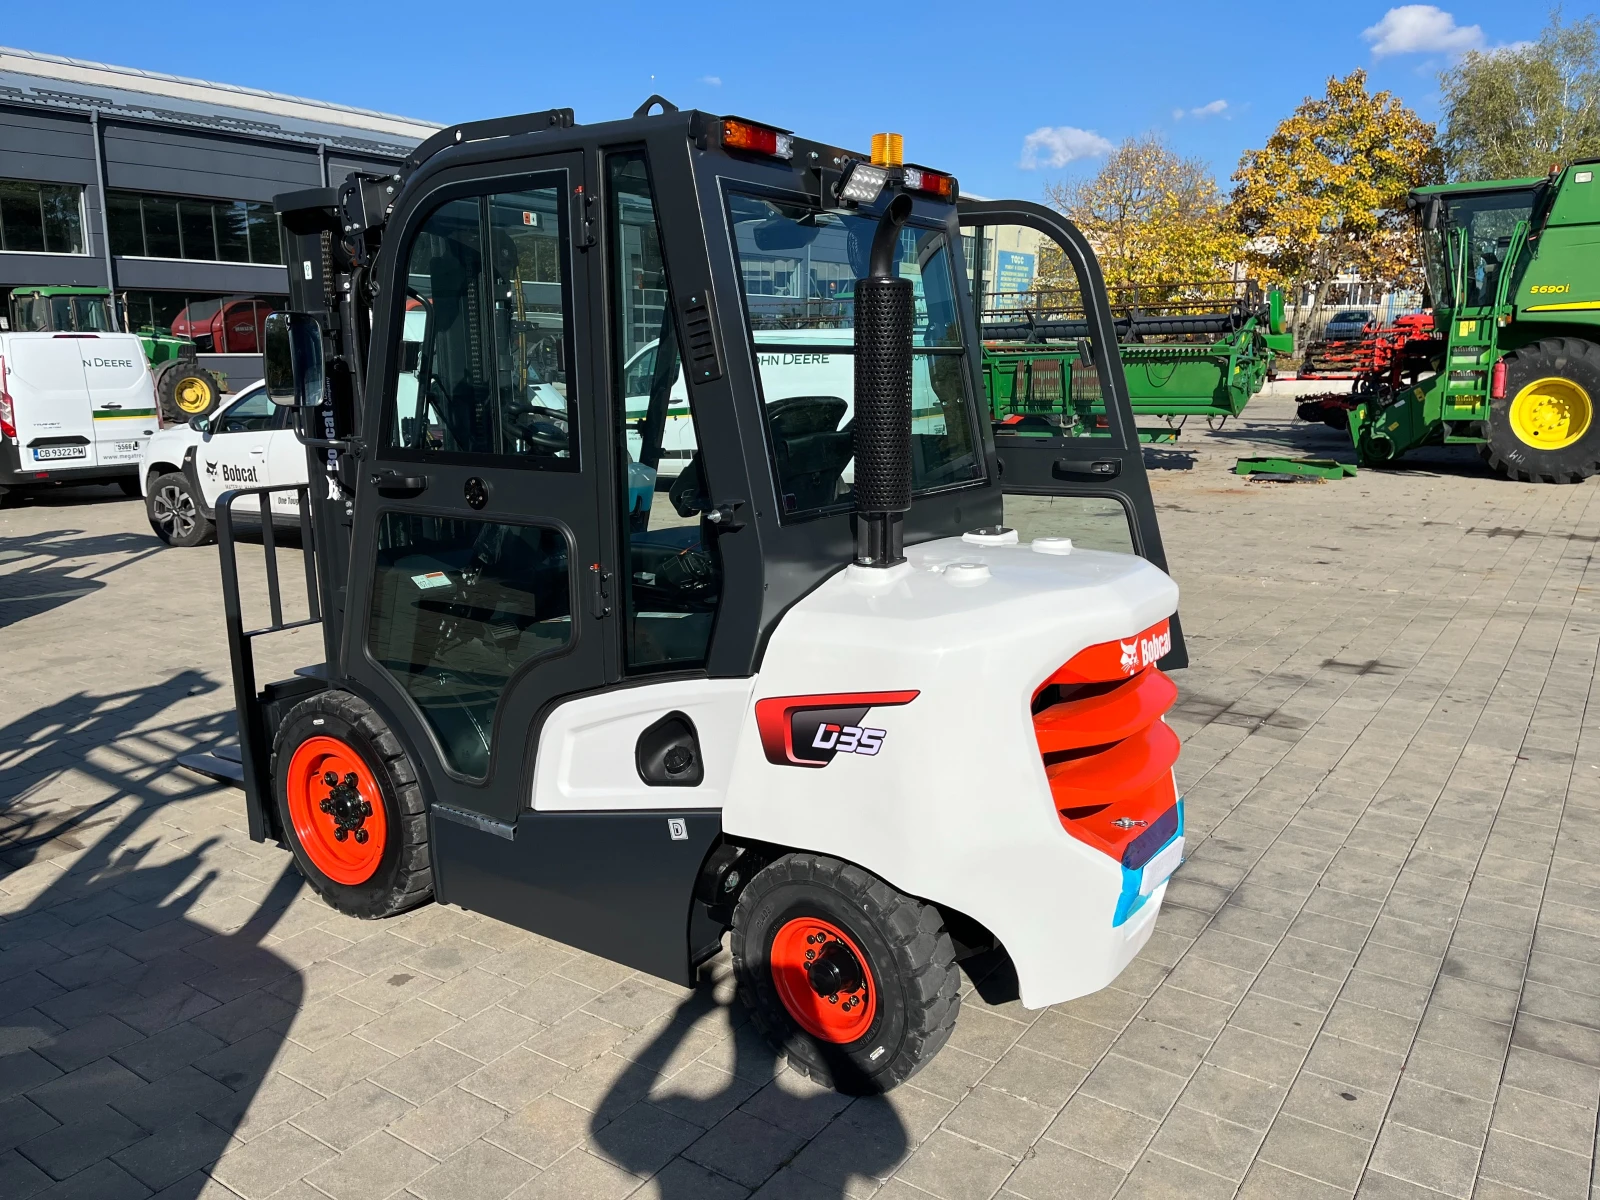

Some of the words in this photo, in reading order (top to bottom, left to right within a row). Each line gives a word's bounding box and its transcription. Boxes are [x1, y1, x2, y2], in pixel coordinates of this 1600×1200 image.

[1530, 283, 1570, 294] S690i
[321, 409, 340, 471] Bocat
[39, 449, 51, 458] CB
[51, 448, 72, 457] 9322
[72, 447, 84, 455] PM
[222, 464, 258, 482] Bobcat
[812, 722, 887, 756] D35
